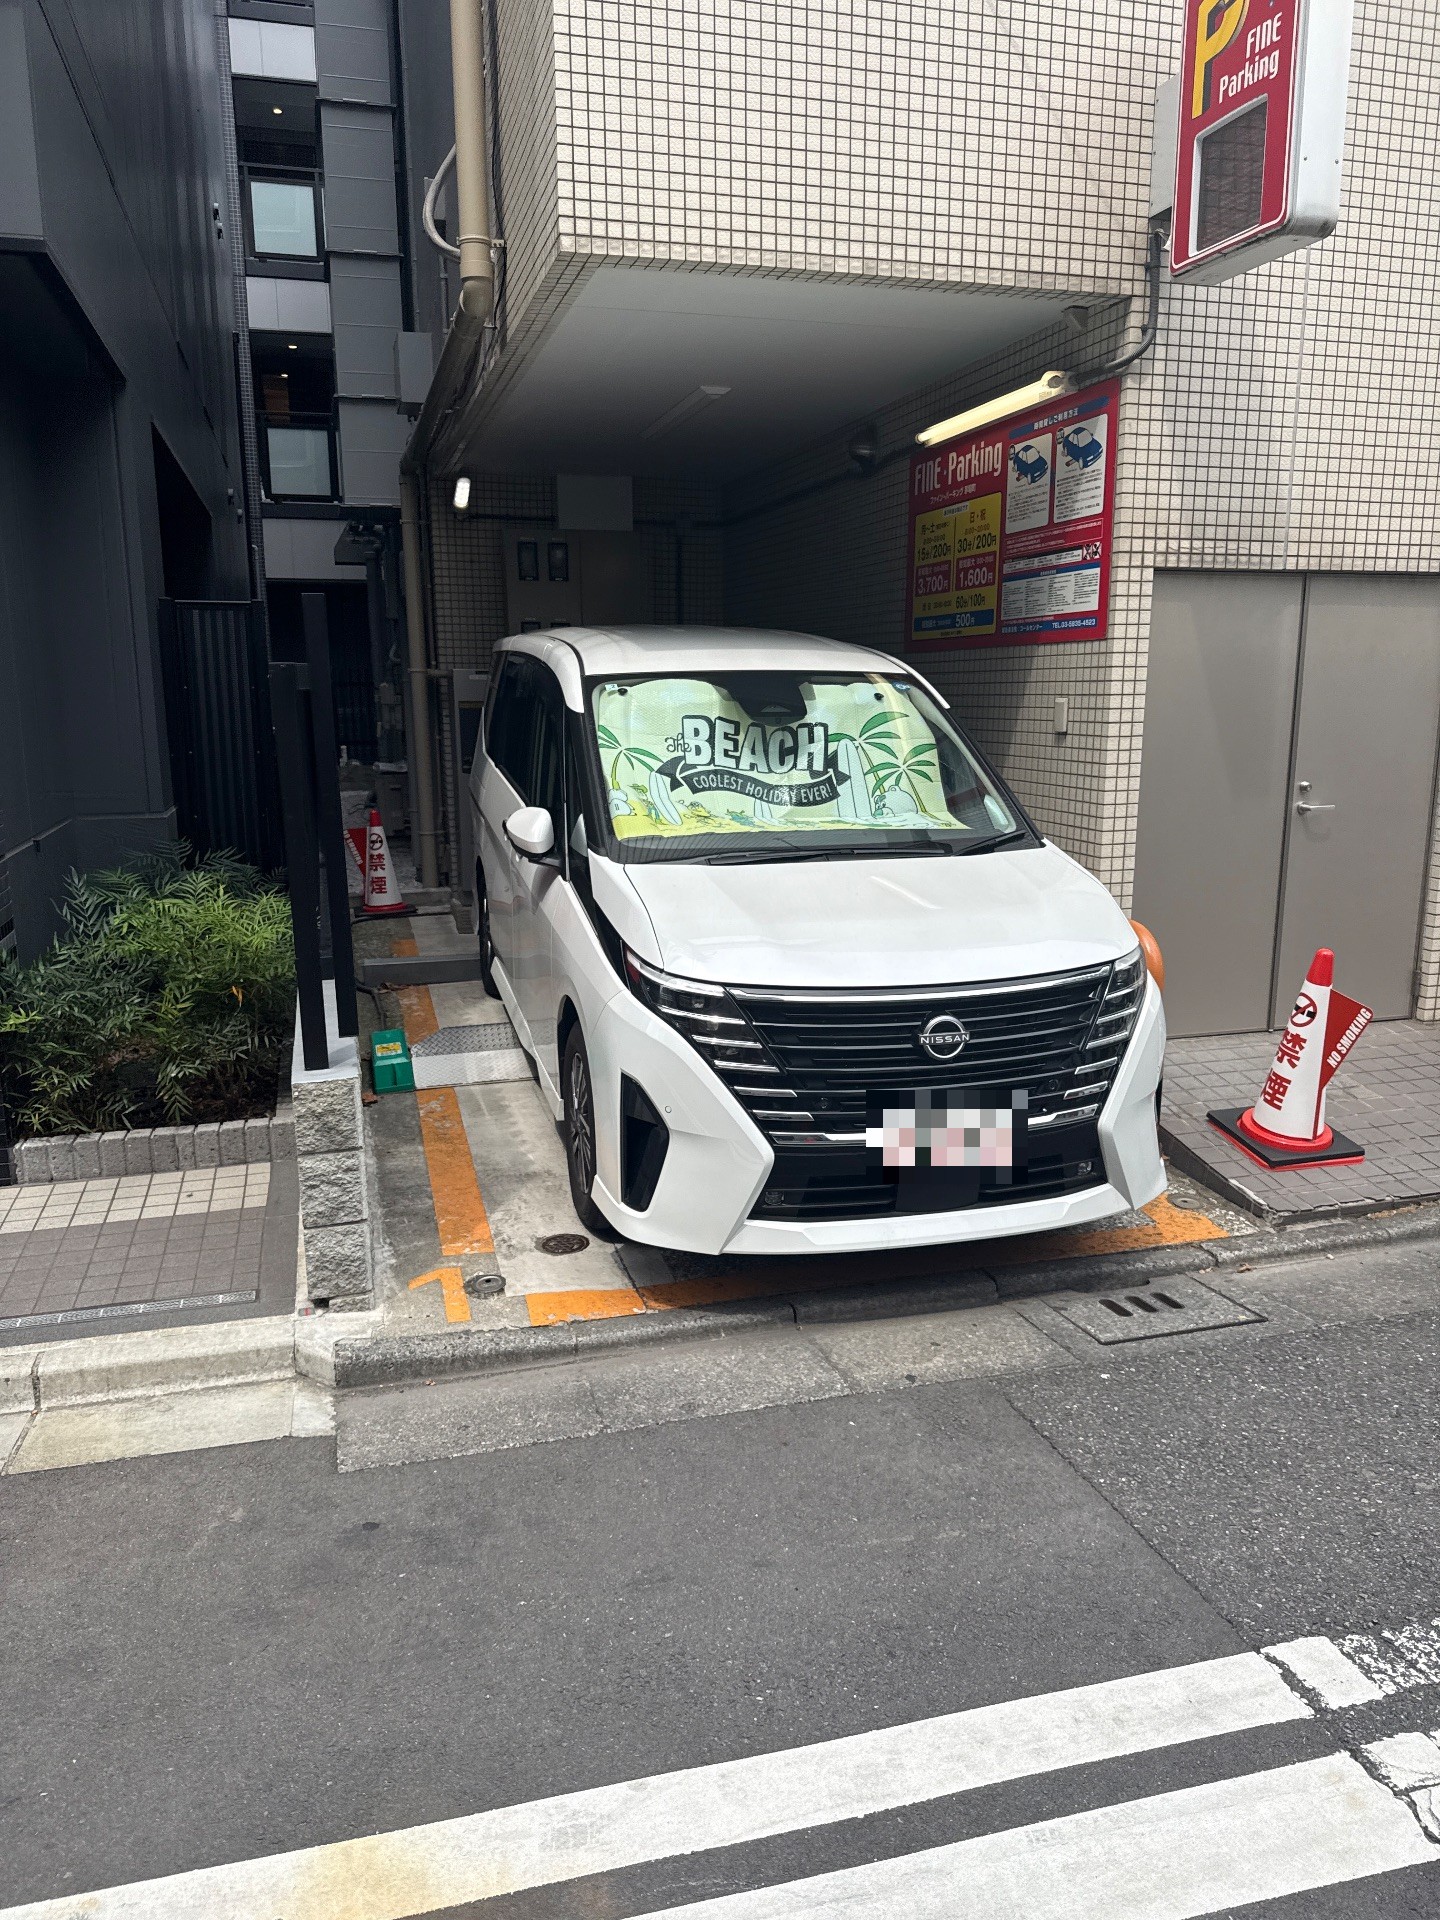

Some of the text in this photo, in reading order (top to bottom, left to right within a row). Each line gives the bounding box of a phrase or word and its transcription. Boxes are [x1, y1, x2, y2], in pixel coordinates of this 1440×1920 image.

[1245, 12, 1283, 58] FINE
[1218, 50, 1280, 104] Parking
[947, 441, 1003, 485] Parking
[959, 566, 993, 588] 1,600円
[681, 714, 829, 775] BEACH
[692, 773, 744, 791] COOLEST
[800, 783, 833, 804] EVER!
[369, 852, 388, 895] 禁煙
[920, 1033, 970, 1044] NISSAN
[1327, 1008, 1372, 1068] NO SMOKING
[1260, 1029, 1307, 1111] 禁煙
[408, 1266, 471, 1323] 1
